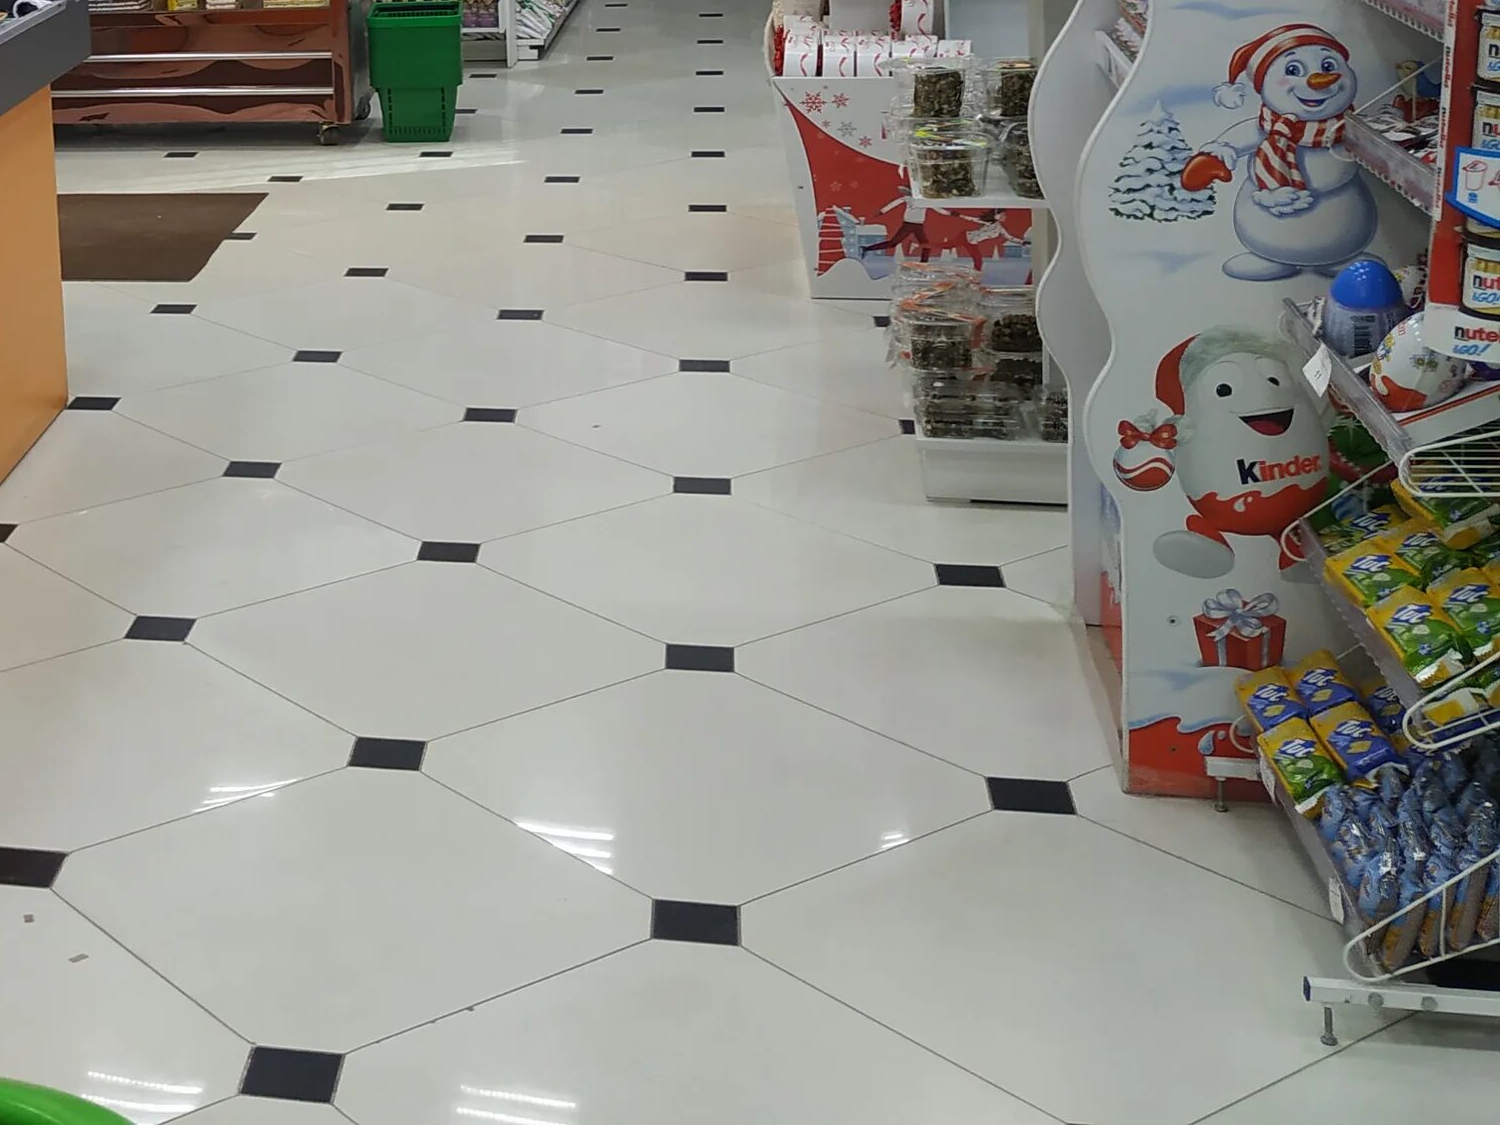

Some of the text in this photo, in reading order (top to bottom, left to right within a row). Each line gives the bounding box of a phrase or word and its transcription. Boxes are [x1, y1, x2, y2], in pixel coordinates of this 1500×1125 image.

[1454, 325, 1500, 343] nute
[1236, 454, 1321, 485] kinder
[1353, 553, 1390, 573] TUC
[1394, 604, 1433, 624] TUC
[1256, 683, 1290, 703] TUC
[1336, 720, 1372, 738] TUC
[1283, 738, 1317, 757] TUC
